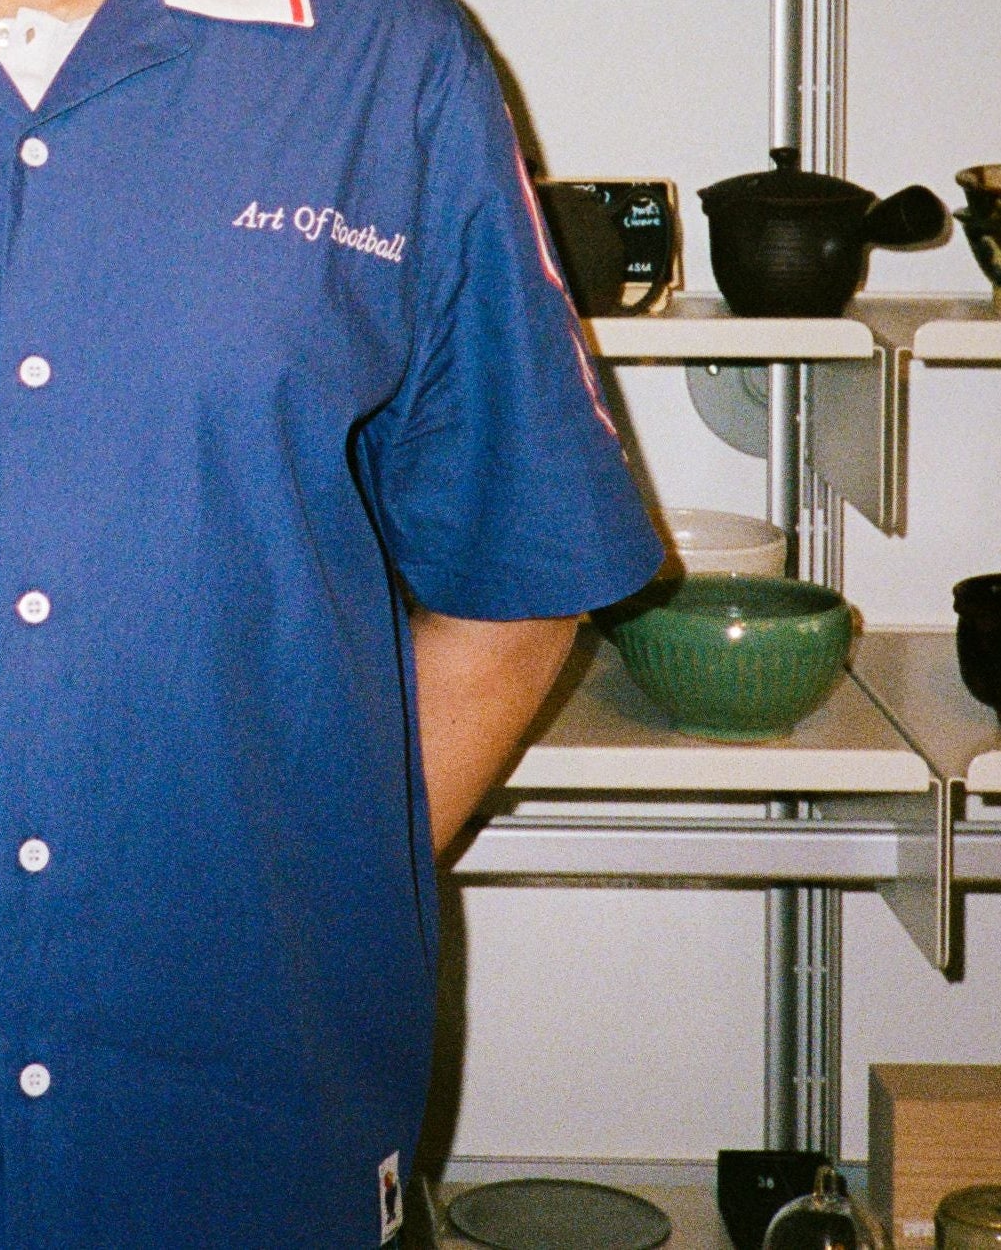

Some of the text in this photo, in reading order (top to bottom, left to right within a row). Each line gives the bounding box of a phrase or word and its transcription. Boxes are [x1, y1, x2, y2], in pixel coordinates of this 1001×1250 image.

[232, 201, 406, 263] Art Of Football
